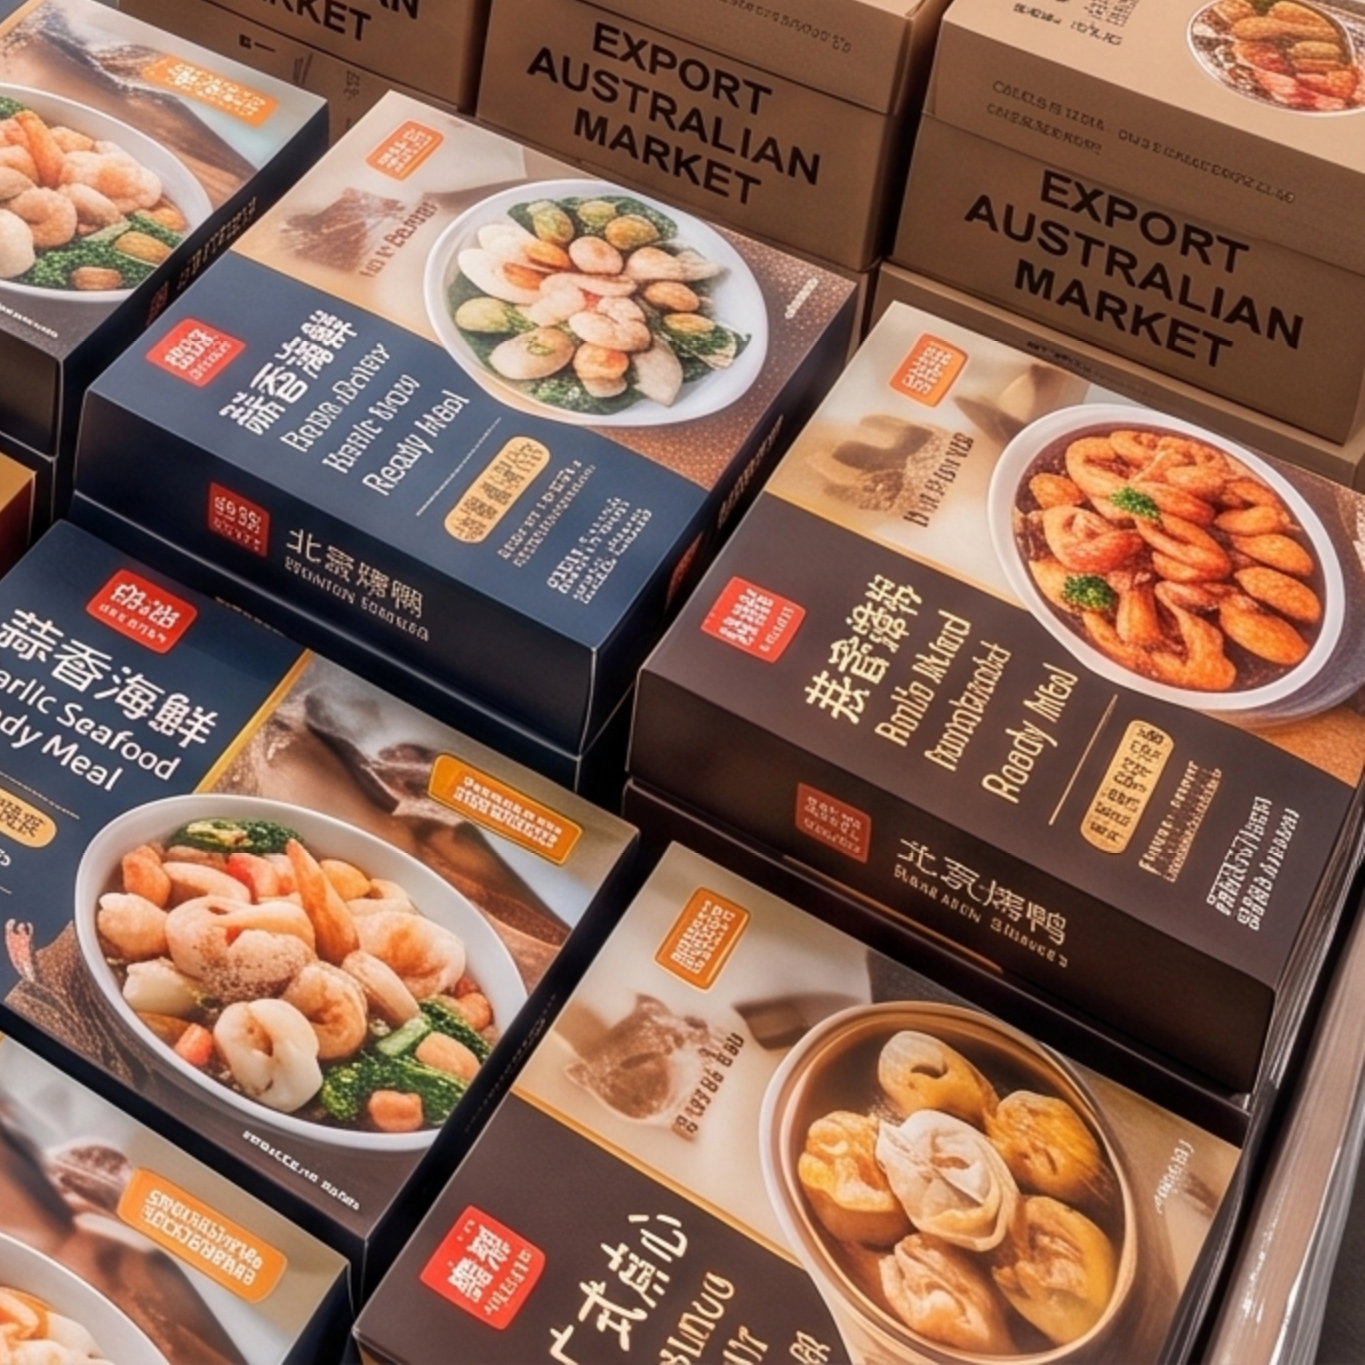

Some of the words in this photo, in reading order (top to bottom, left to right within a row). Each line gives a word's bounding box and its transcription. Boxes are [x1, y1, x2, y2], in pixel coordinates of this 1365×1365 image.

[593, 22, 772, 115] EXPORT
[527, 62, 820, 185] AUSTRALIAN
[575, 108, 761, 204] MARKET
[1041, 170, 1249, 273] EXPORT
[965, 196, 1303, 349] AUSTRALIAN
[1015, 259, 1233, 367] MARKET
[42, 735, 122, 790] Meal
[57, 703, 180, 779] Seafood
